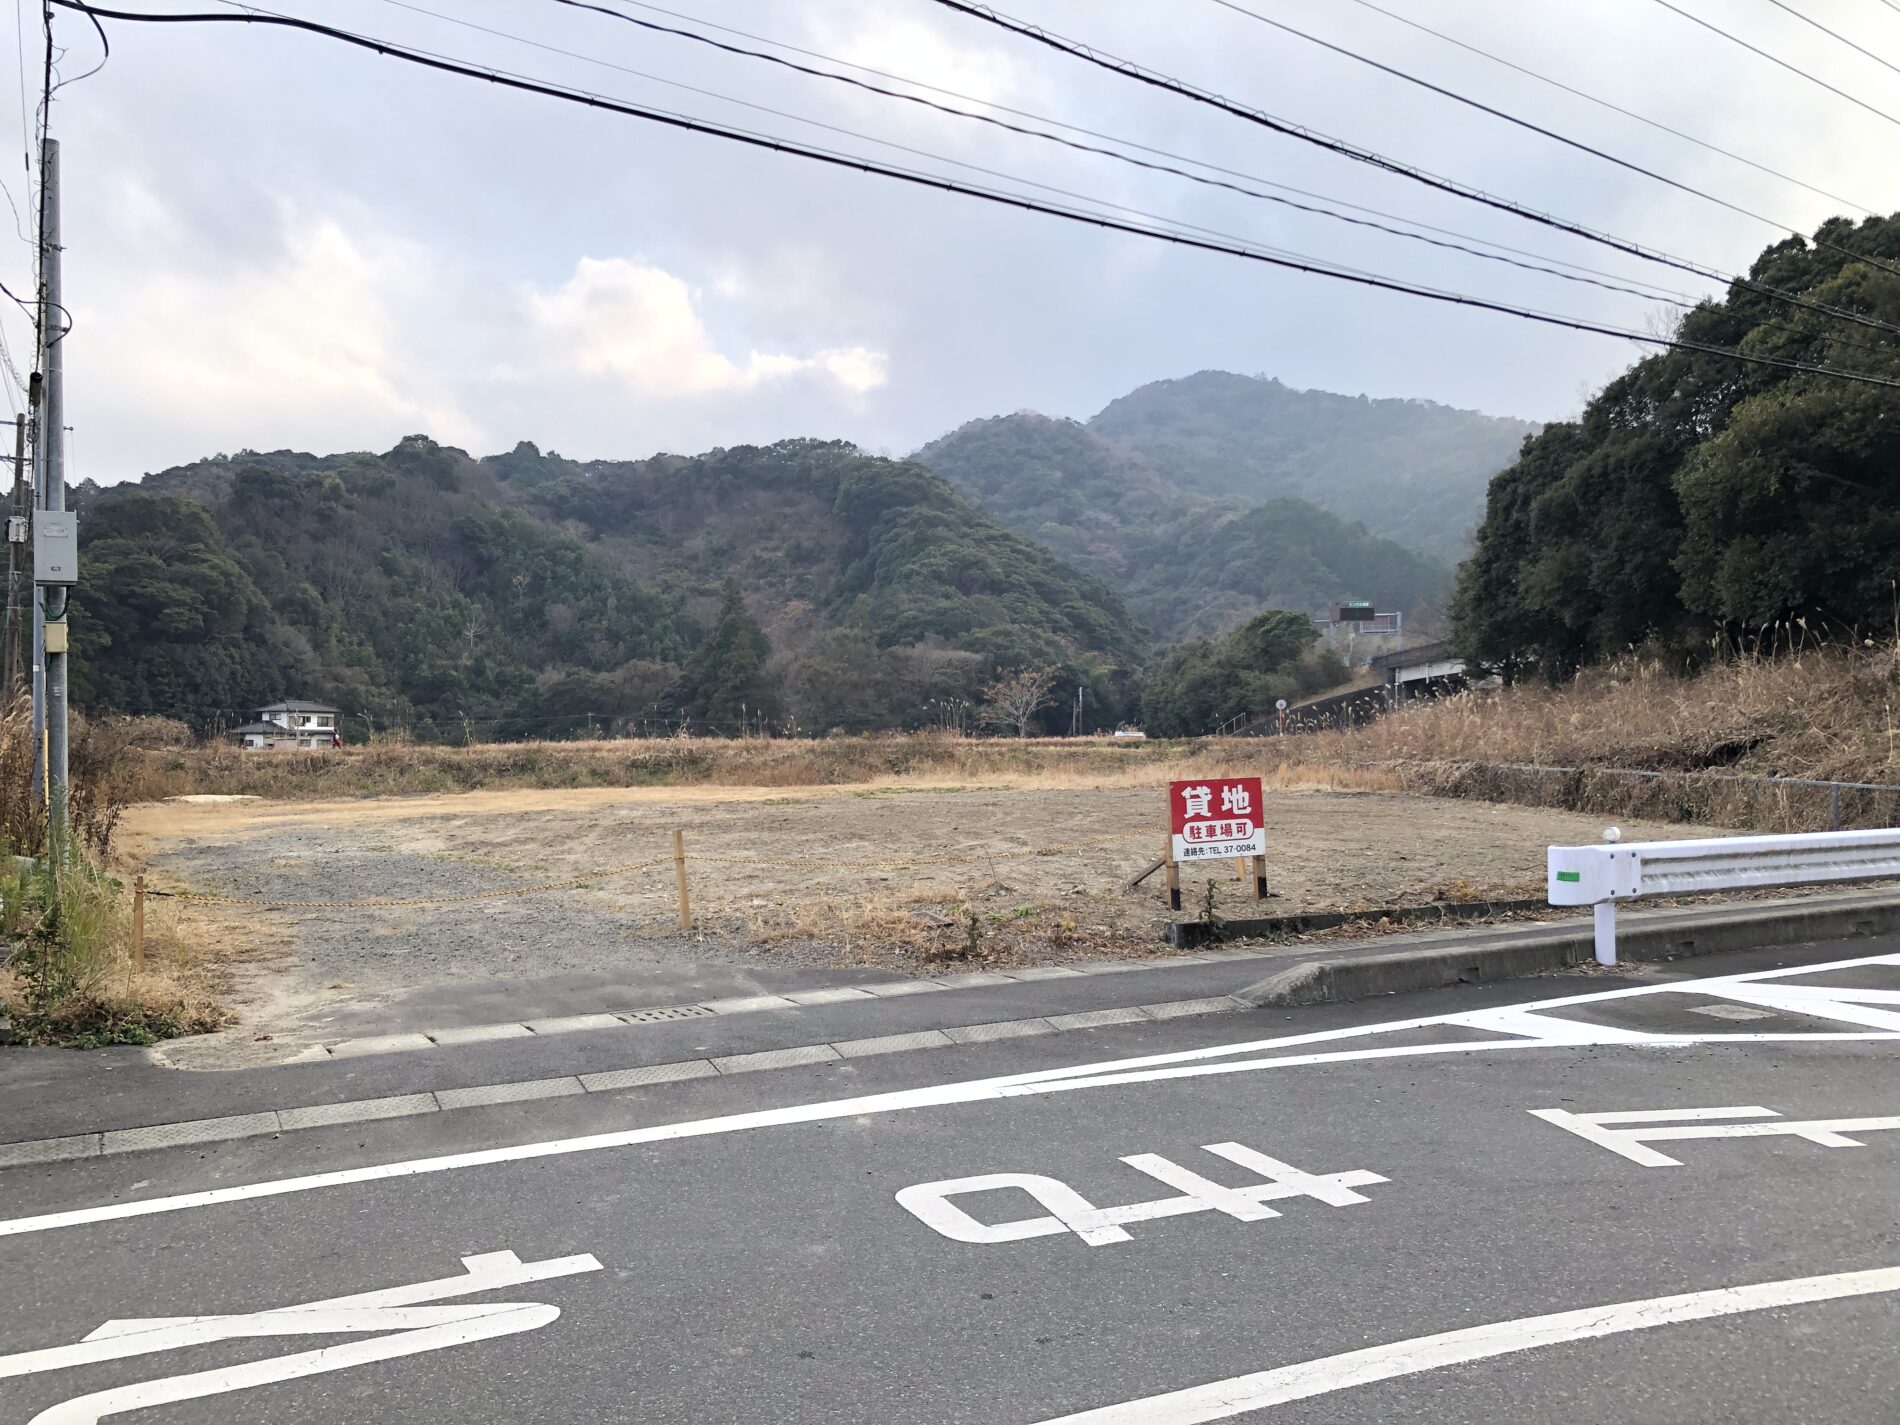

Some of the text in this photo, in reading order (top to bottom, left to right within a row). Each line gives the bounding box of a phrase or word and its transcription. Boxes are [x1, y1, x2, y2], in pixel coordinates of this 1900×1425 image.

[1181, 784, 1252, 818] 貸地
[1189, 822, 1248, 840] 駐車場可
[1224, 844, 1256, 854] 37-0084
